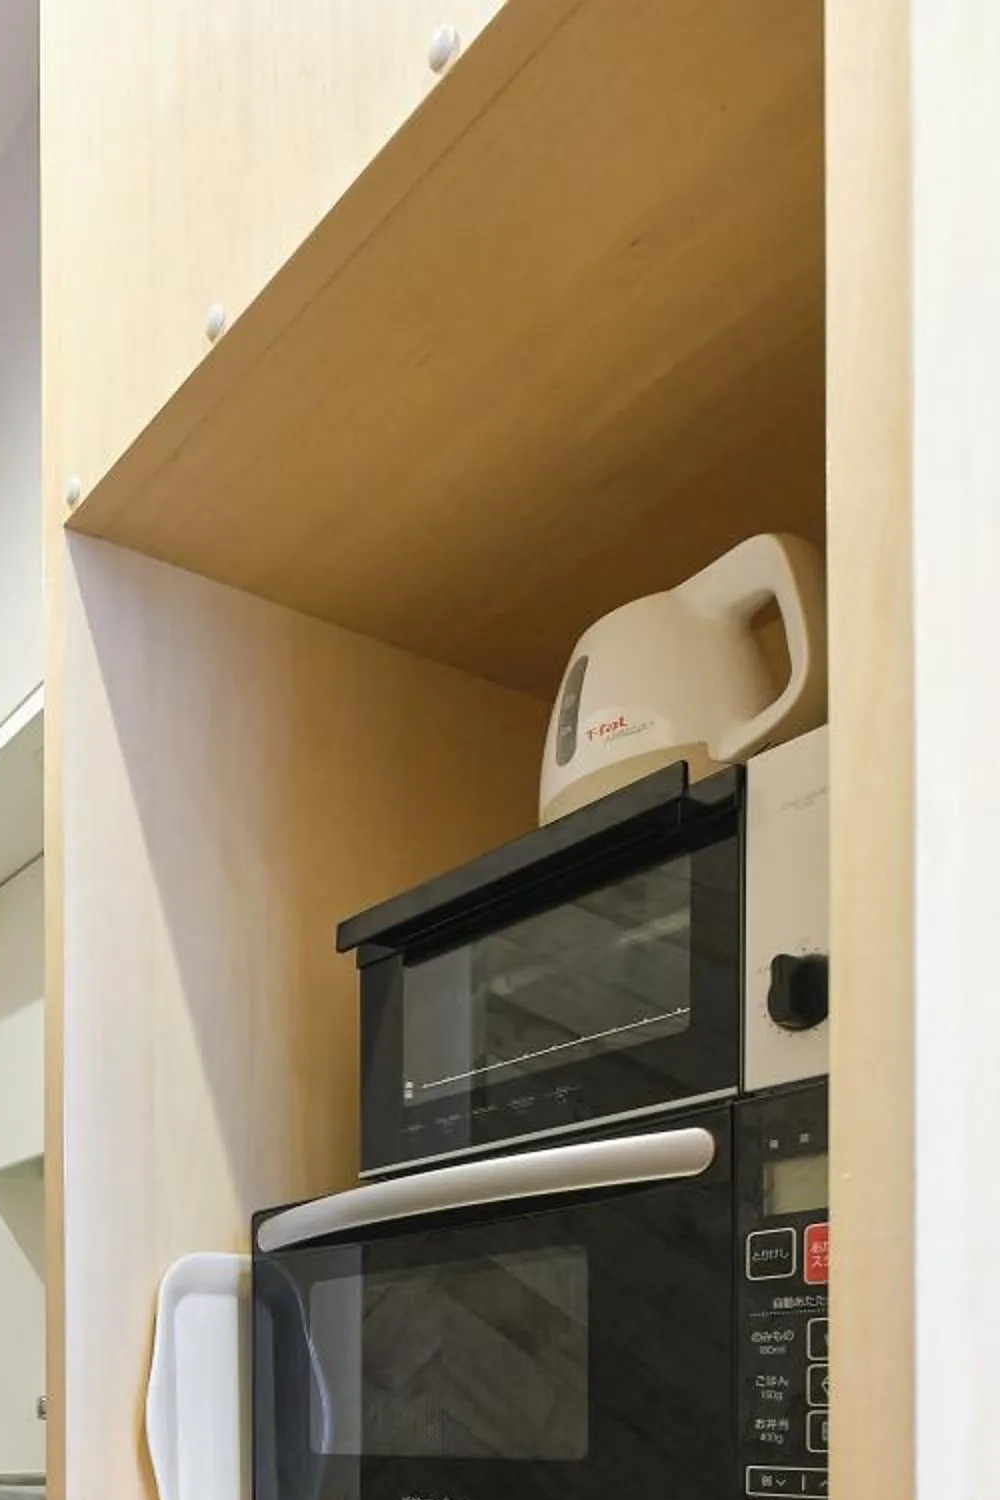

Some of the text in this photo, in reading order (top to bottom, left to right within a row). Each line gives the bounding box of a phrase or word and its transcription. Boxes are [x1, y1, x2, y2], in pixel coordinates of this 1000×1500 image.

[752, 1248, 790, 1261] とりけし
[751, 1330, 795, 1342] のみもの
[755, 1375, 789, 1387] ごはん
[755, 1418, 789, 1431] お弁当
